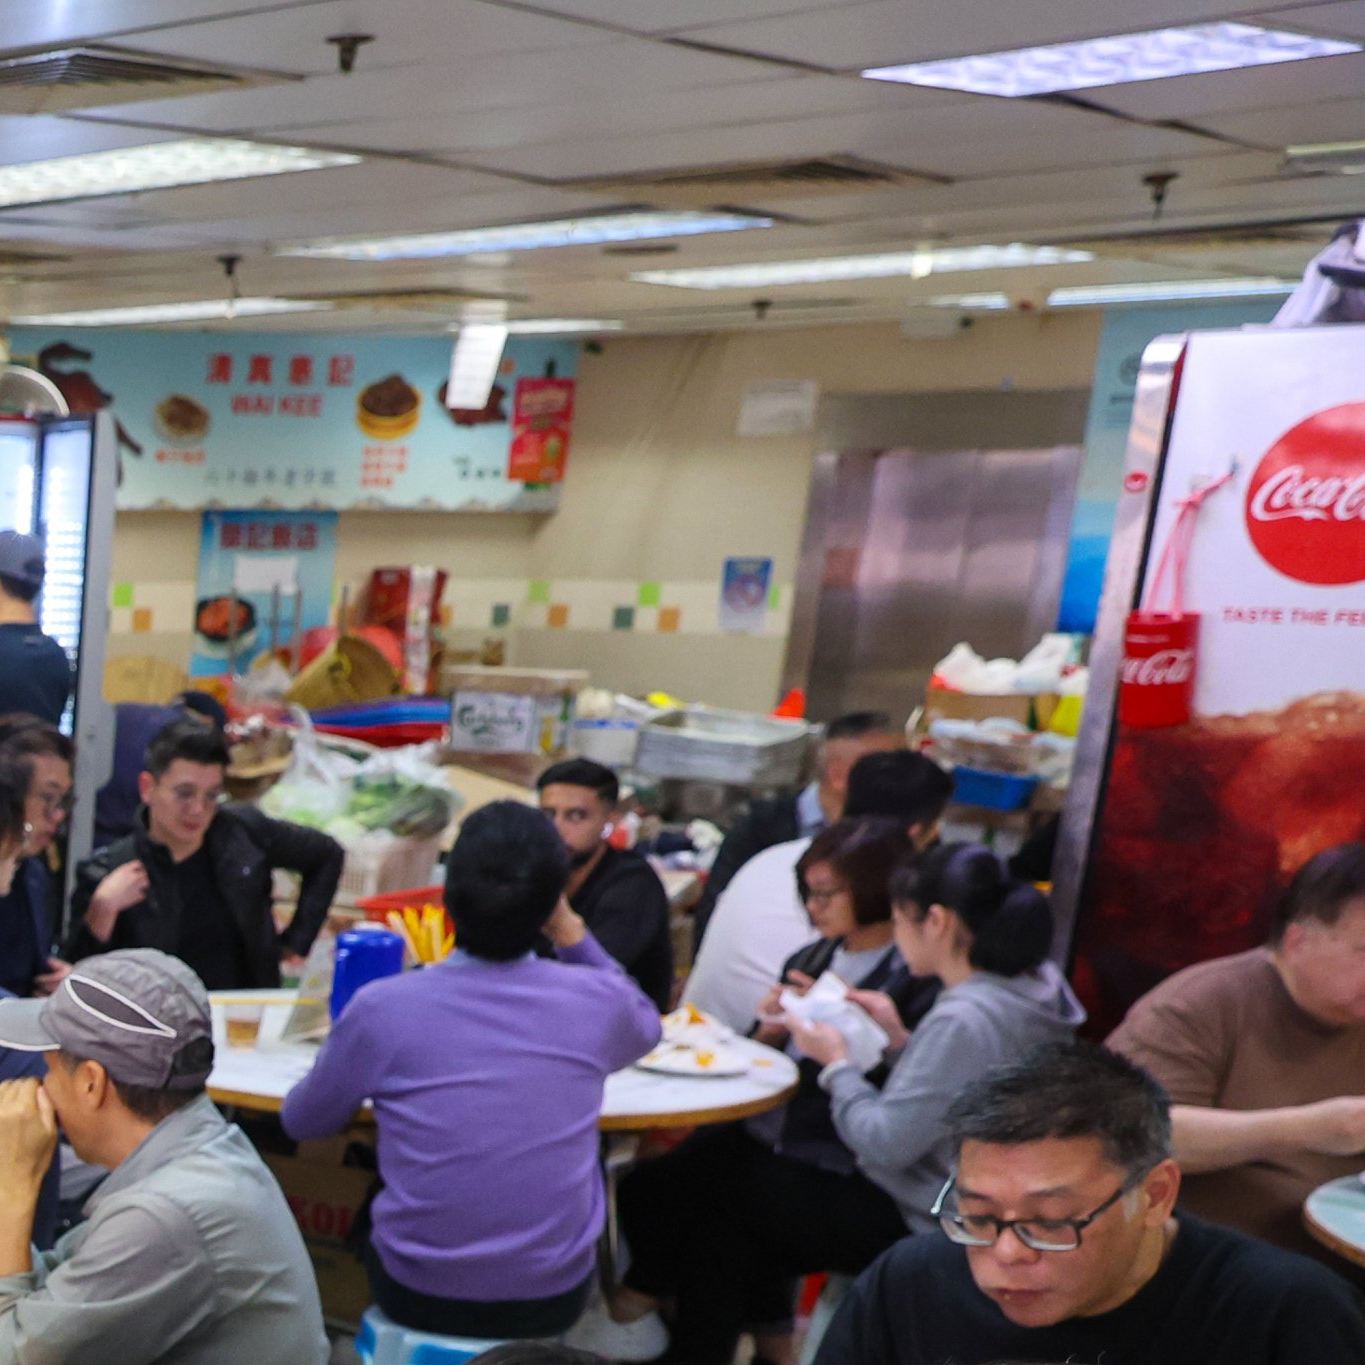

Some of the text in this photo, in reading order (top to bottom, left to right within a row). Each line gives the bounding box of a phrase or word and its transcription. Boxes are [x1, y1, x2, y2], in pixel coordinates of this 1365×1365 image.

[1223, 607, 1365, 627] TASTE THE FE
